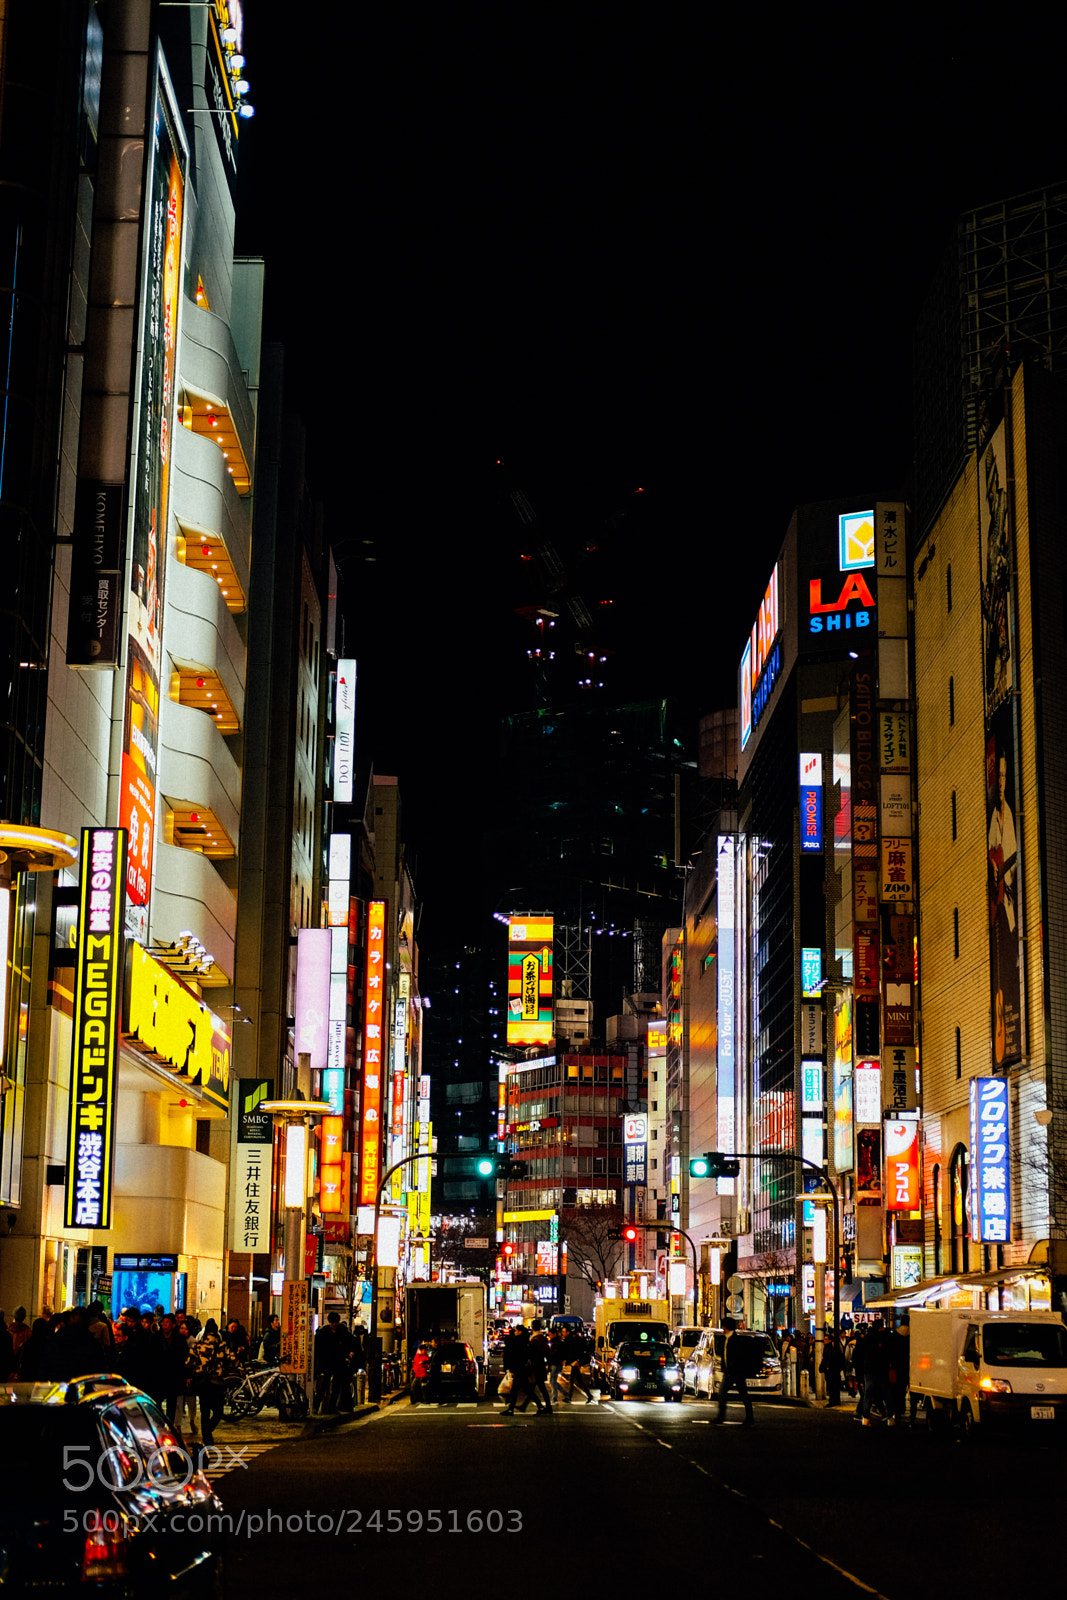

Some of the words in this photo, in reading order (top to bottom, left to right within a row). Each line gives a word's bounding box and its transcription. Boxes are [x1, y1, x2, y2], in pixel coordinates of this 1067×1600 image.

[93, 491, 106, 565] KOMEHYO
[883, 510, 898, 568] 清水ビル
[96, 579, 110, 638] 買取センター
[855, 672, 872, 725] SAITO
[884, 715, 894, 765] ミスサイゴン
[897, 715, 907, 758] ベトナム料理
[806, 791, 817, 836] PROMISE
[883, 840, 910, 849] フリー
[887, 850, 906, 883] 麻雀
[855, 873, 867, 907] エステ
[884, 883, 911, 893] ZOO
[365, 926, 382, 1089] カラオケ歌広場
[524, 960, 536, 1015] お茶づけ海苔
[720, 1013, 732, 1038] Your
[887, 1012, 912, 1021] MINT
[720, 1038, 732, 1057] For
[892, 1049, 907, 1109] 富士屋酒店
[242, 1114, 269, 1124] SMBC
[626, 1119, 646, 1139] OS
[626, 1144, 645, 1163] 調剤
[626, 1164, 645, 1182] 薬局
[981, 1080, 1006, 1241] クロサワ楽器店
[75, 1132, 103, 1225] 渋谷本店
[243, 1149, 262, 1248] 三井住友銀行
[895, 1162, 910, 1203] アコム
[853, 1313, 880, 1323] SALE
